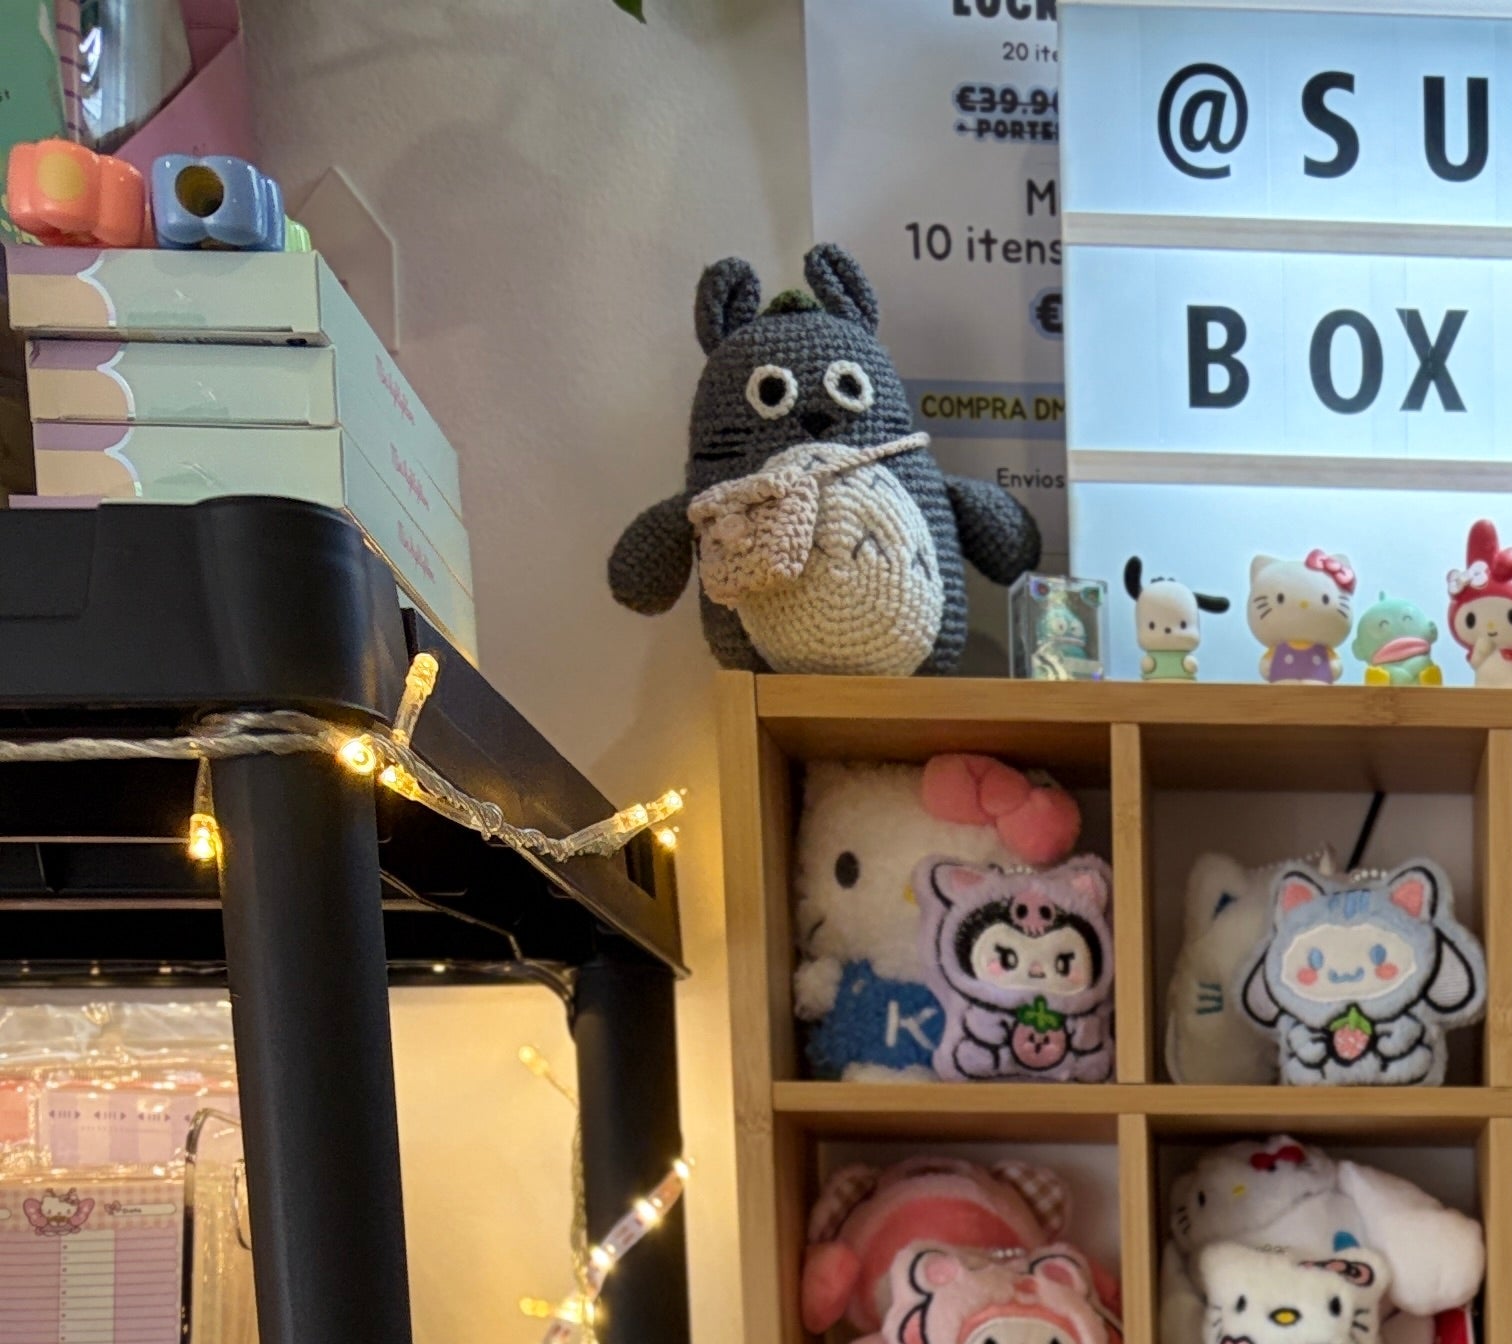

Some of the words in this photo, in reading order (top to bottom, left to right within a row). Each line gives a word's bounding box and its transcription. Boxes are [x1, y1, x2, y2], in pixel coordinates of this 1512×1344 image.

[1002, 41, 1029, 61] 20
[956, 86, 1059, 116] €39.9
[976, 118, 1059, 140] PORTE
[905, 221, 952, 261] 10
[1186, 304, 1470, 415] BOX
[920, 394, 1027, 420] COMPRA
